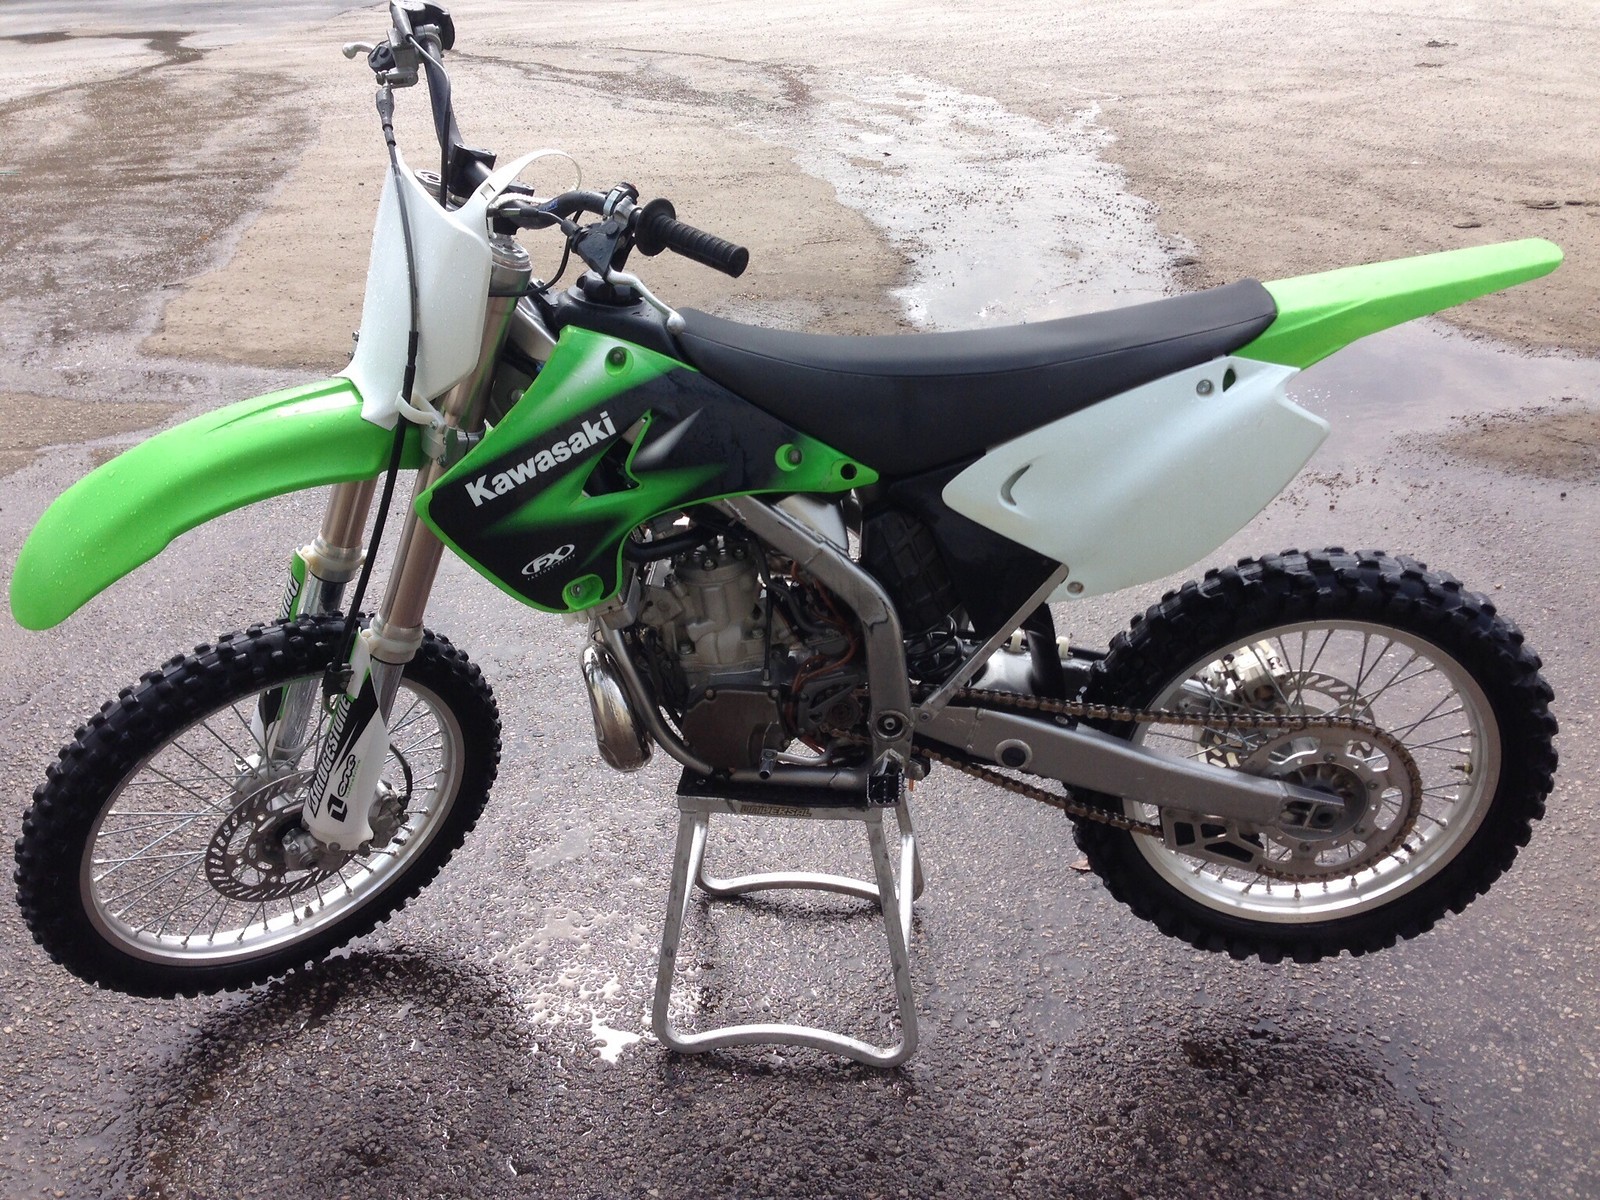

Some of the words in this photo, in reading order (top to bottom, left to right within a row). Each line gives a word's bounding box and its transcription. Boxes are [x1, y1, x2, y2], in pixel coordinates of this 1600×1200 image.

[464, 410, 617, 507] Kawasaki
[531, 545, 570, 574] FX
[306, 693, 351, 818] BRIDGESTONE
